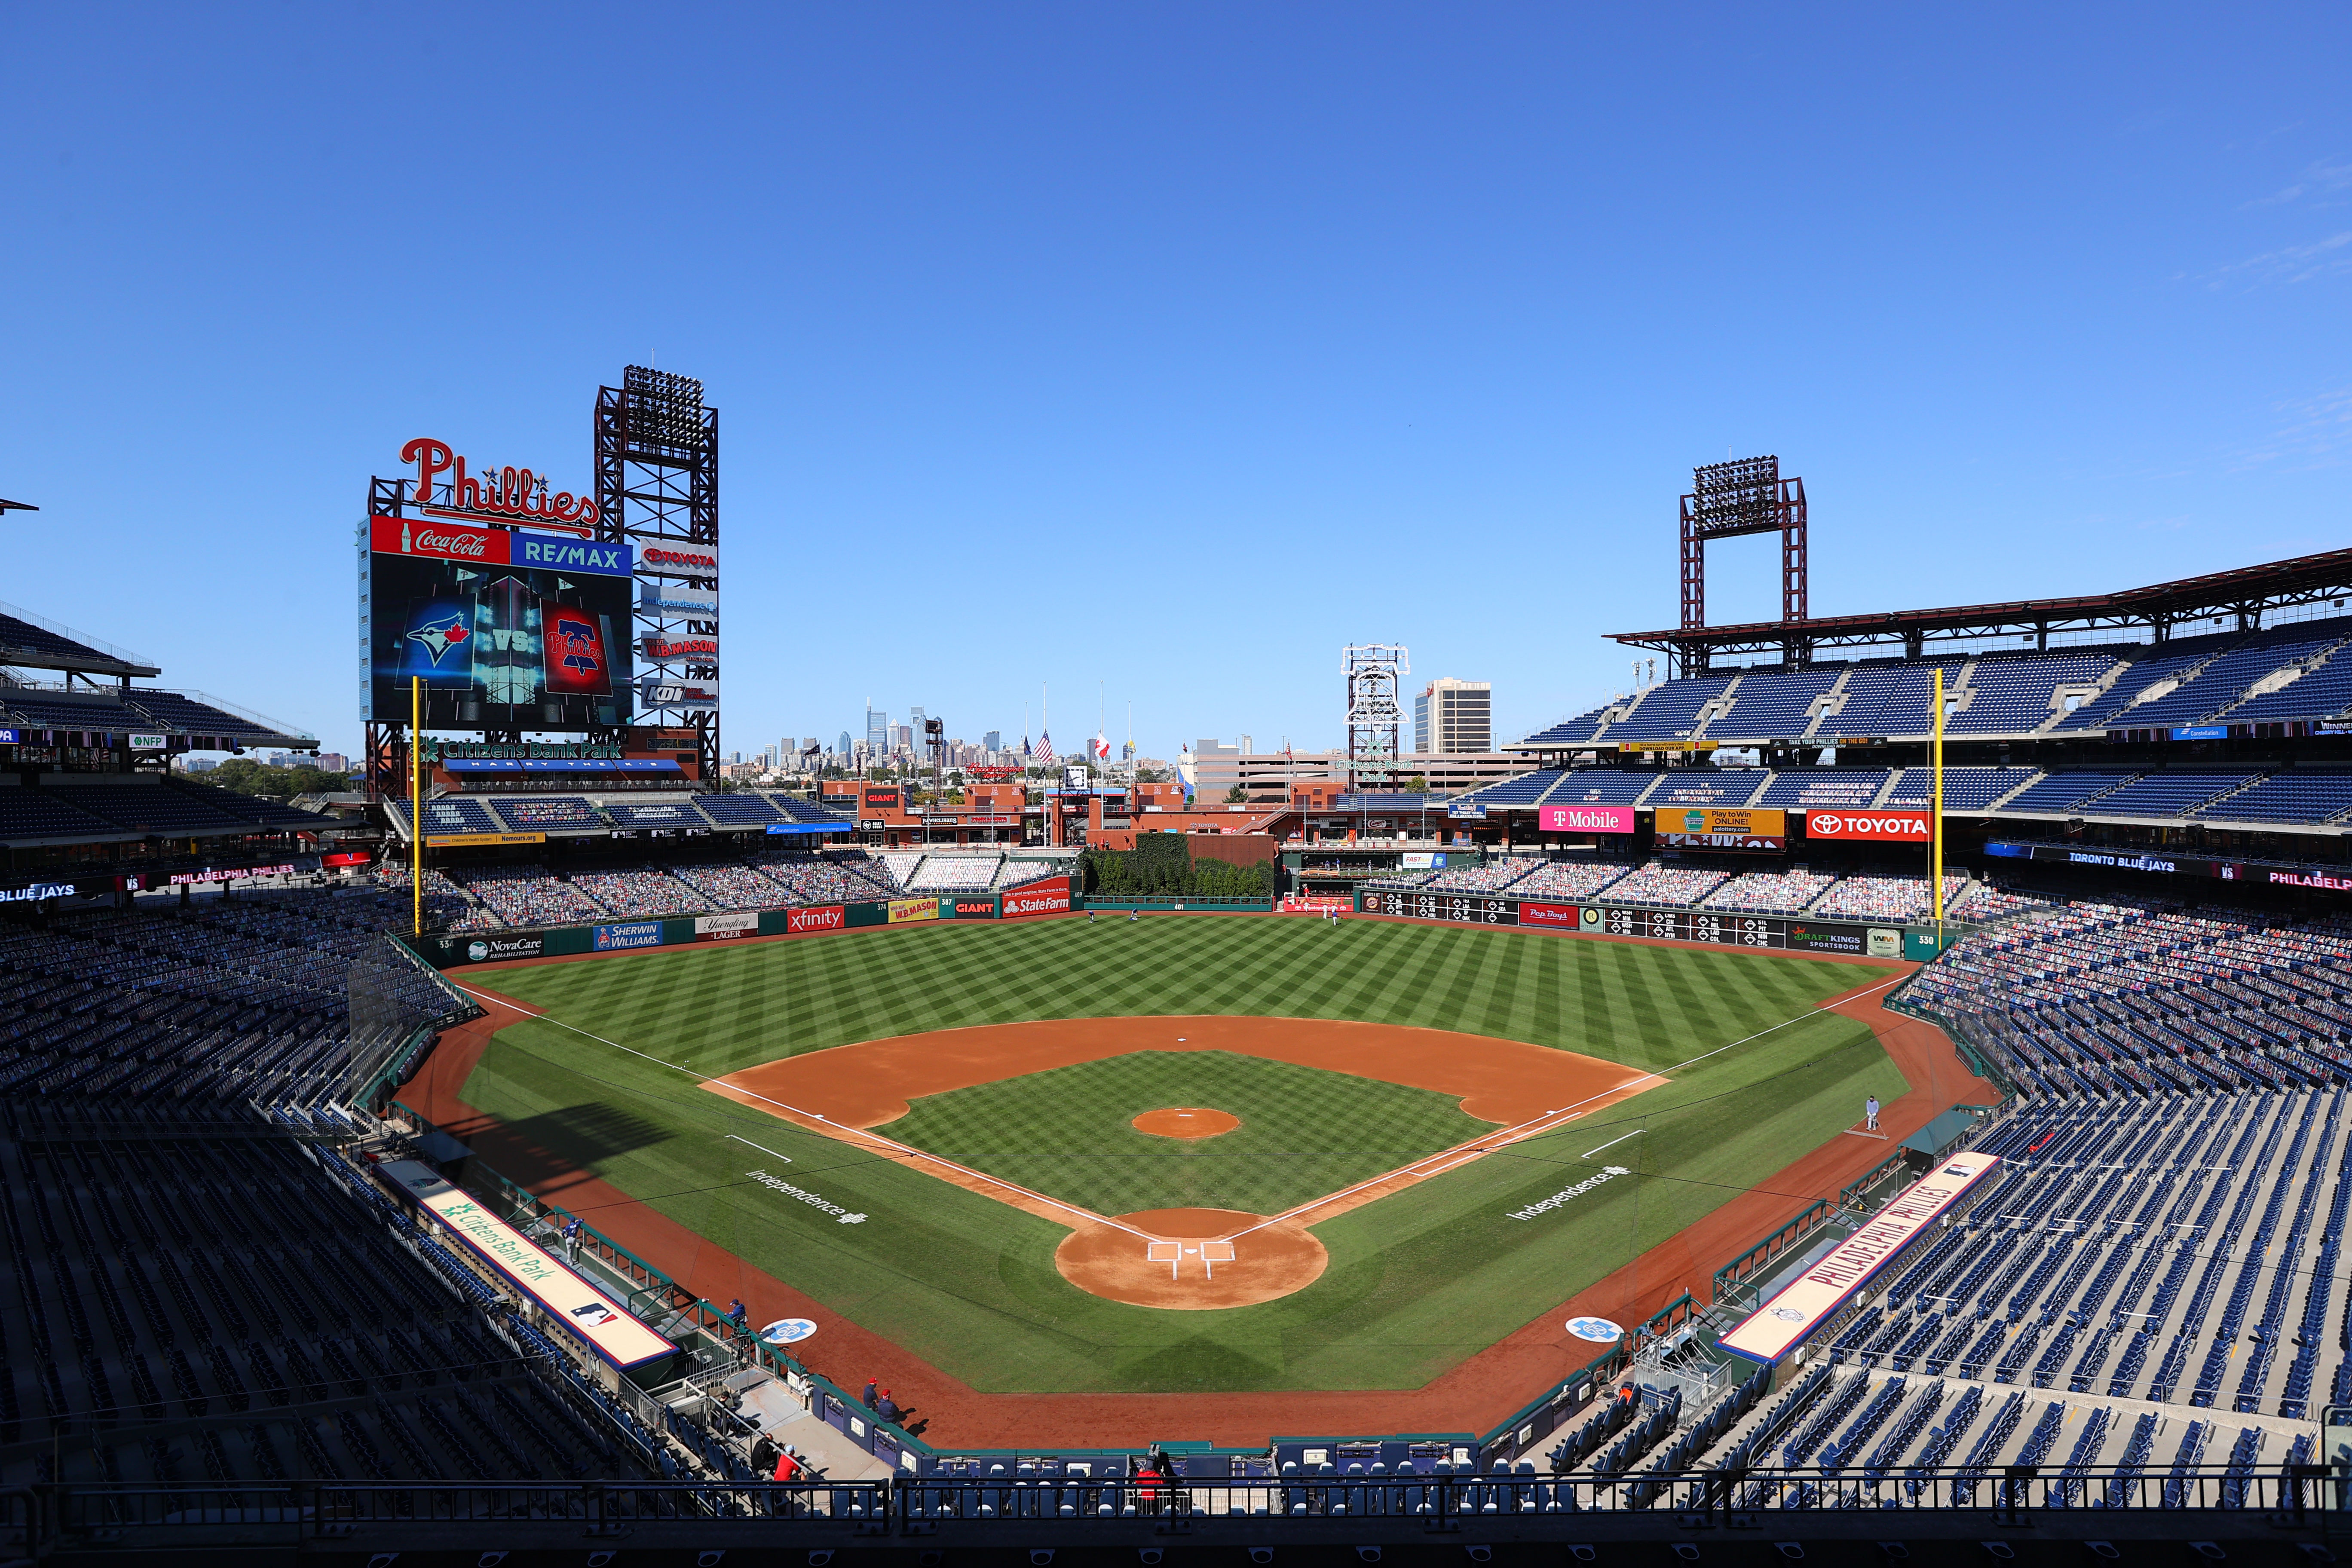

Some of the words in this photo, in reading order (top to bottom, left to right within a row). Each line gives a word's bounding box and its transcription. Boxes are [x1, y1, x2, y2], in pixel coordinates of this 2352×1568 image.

[399, 438, 600, 525] Phillies
[416, 529, 489, 557] Coca-Cola
[526, 541, 619, 569] RE/MAX
[662, 551, 715, 567] TOYOTA
[643, 596, 706, 609] Independence
[493, 629, 529, 652] VS
[546, 631, 603, 660] Phillies
[2321, 721, 2352, 730] WINNE
[143, 737, 162, 747] NFP
[443, 741, 526, 759] Citizens
[530, 741, 579, 759] Bank
[581, 741, 622, 759] Park
[1336, 759, 1383, 770] Citizens
[1384, 758, 1414, 770] Bank
[1362, 771, 1388, 782] Park
[1568, 811, 1619, 828] Mobile
[1844, 818, 1928, 834] TOYOTA
[2069, 852, 2115, 865] TORONTO
[2118, 857, 2145, 868] BLUE
[2147, 860, 2175, 872] JAYS
[171, 869, 249, 884] PHILADELPHIA
[252, 864, 295, 876] PHILLIES
[2222, 867, 2234, 879] VS
[126, 878, 138, 890] VS
[2269, 872, 2352, 890] PHILADELP
[39, 885, 74, 900] JAYS
[956, 903, 993, 913] GIANT
[1530, 909, 1546, 918] Pep
[1547, 910, 1568, 921] Boys
[703, 916, 751, 932] Yuengling
[791, 909, 841, 931] xfinity
[612, 925, 657, 937] SHERWIN
[714, 930, 741, 940] LAGER
[1794, 933, 1861, 944] DRAFTKINGS
[439, 940, 454, 949] 334
[489, 938, 542, 952] NovaCare
[611, 935, 657, 948] WILLIAMS
[1810, 941, 1860, 950] SPORTSBOOK
[1918, 935, 1934, 945] 330
[489, 949, 540, 959] REHABILITATION
[745, 1169, 846, 1216] Independence
[1506, 1173, 1614, 1221] Independence
[1807, 1221, 1912, 1289] PHILADELPHIA
[1888, 1186, 1953, 1221] PHILLIES
[459, 1215, 504, 1243] Citizens
[492, 1240, 533, 1263] Bank
[516, 1259, 556, 1281] Park
